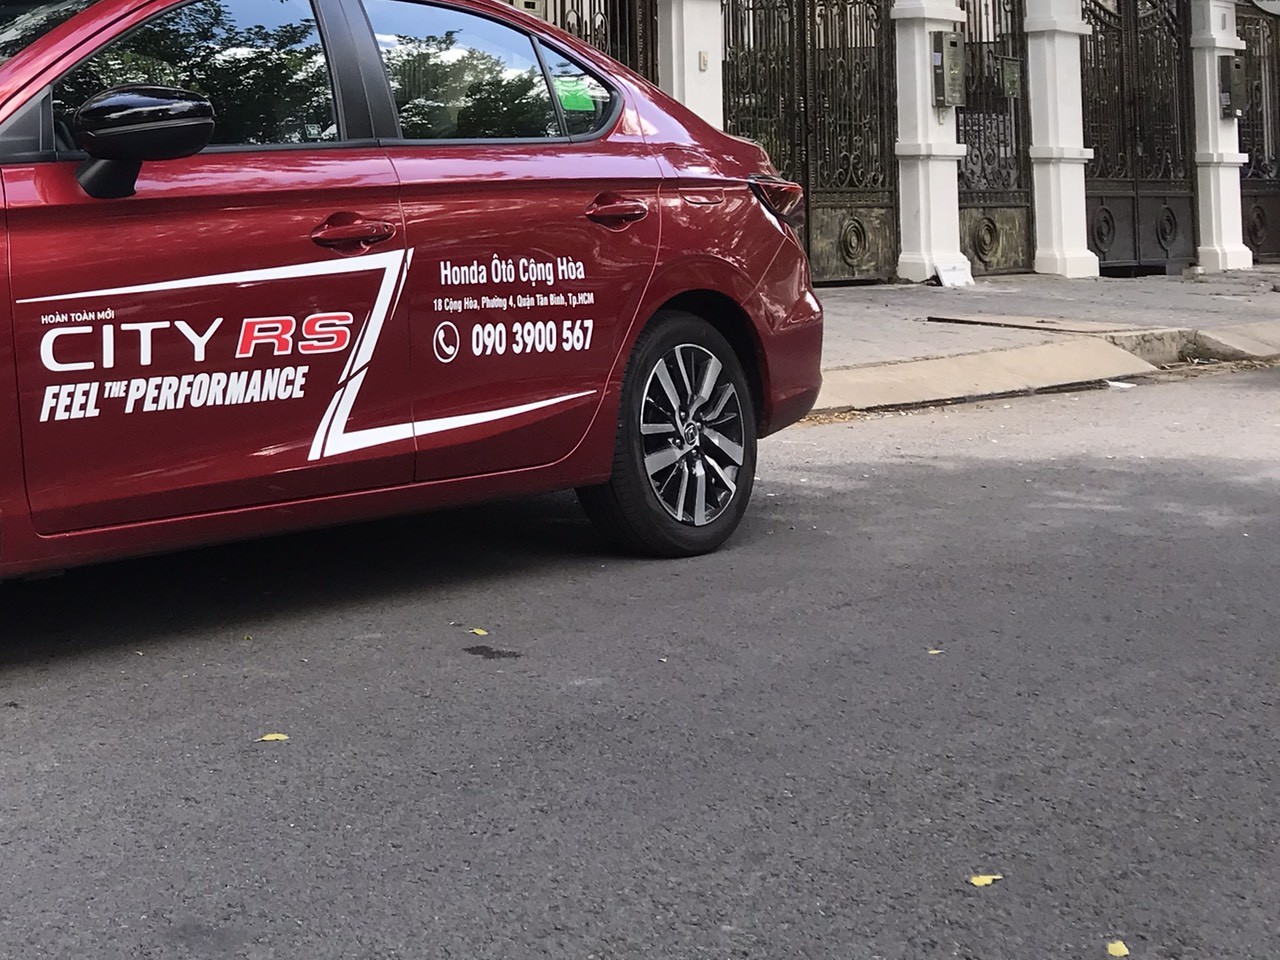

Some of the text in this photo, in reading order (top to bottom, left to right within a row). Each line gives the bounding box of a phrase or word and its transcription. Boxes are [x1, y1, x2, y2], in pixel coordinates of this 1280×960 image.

[440, 253, 586, 287] Honda Ôtô Cộng Hòa
[41, 307, 115, 325] HOÀN TOÀN MỚI
[433, 291, 595, 313] 18 Cộng Hòa, Phường 4, Quận Tân Bình, Tp.HCM
[39, 311, 354, 373] CITY RS
[471, 319, 594, 356] 090 3900 567
[39, 365, 310, 423] FEEL THE PERFORMANCE
